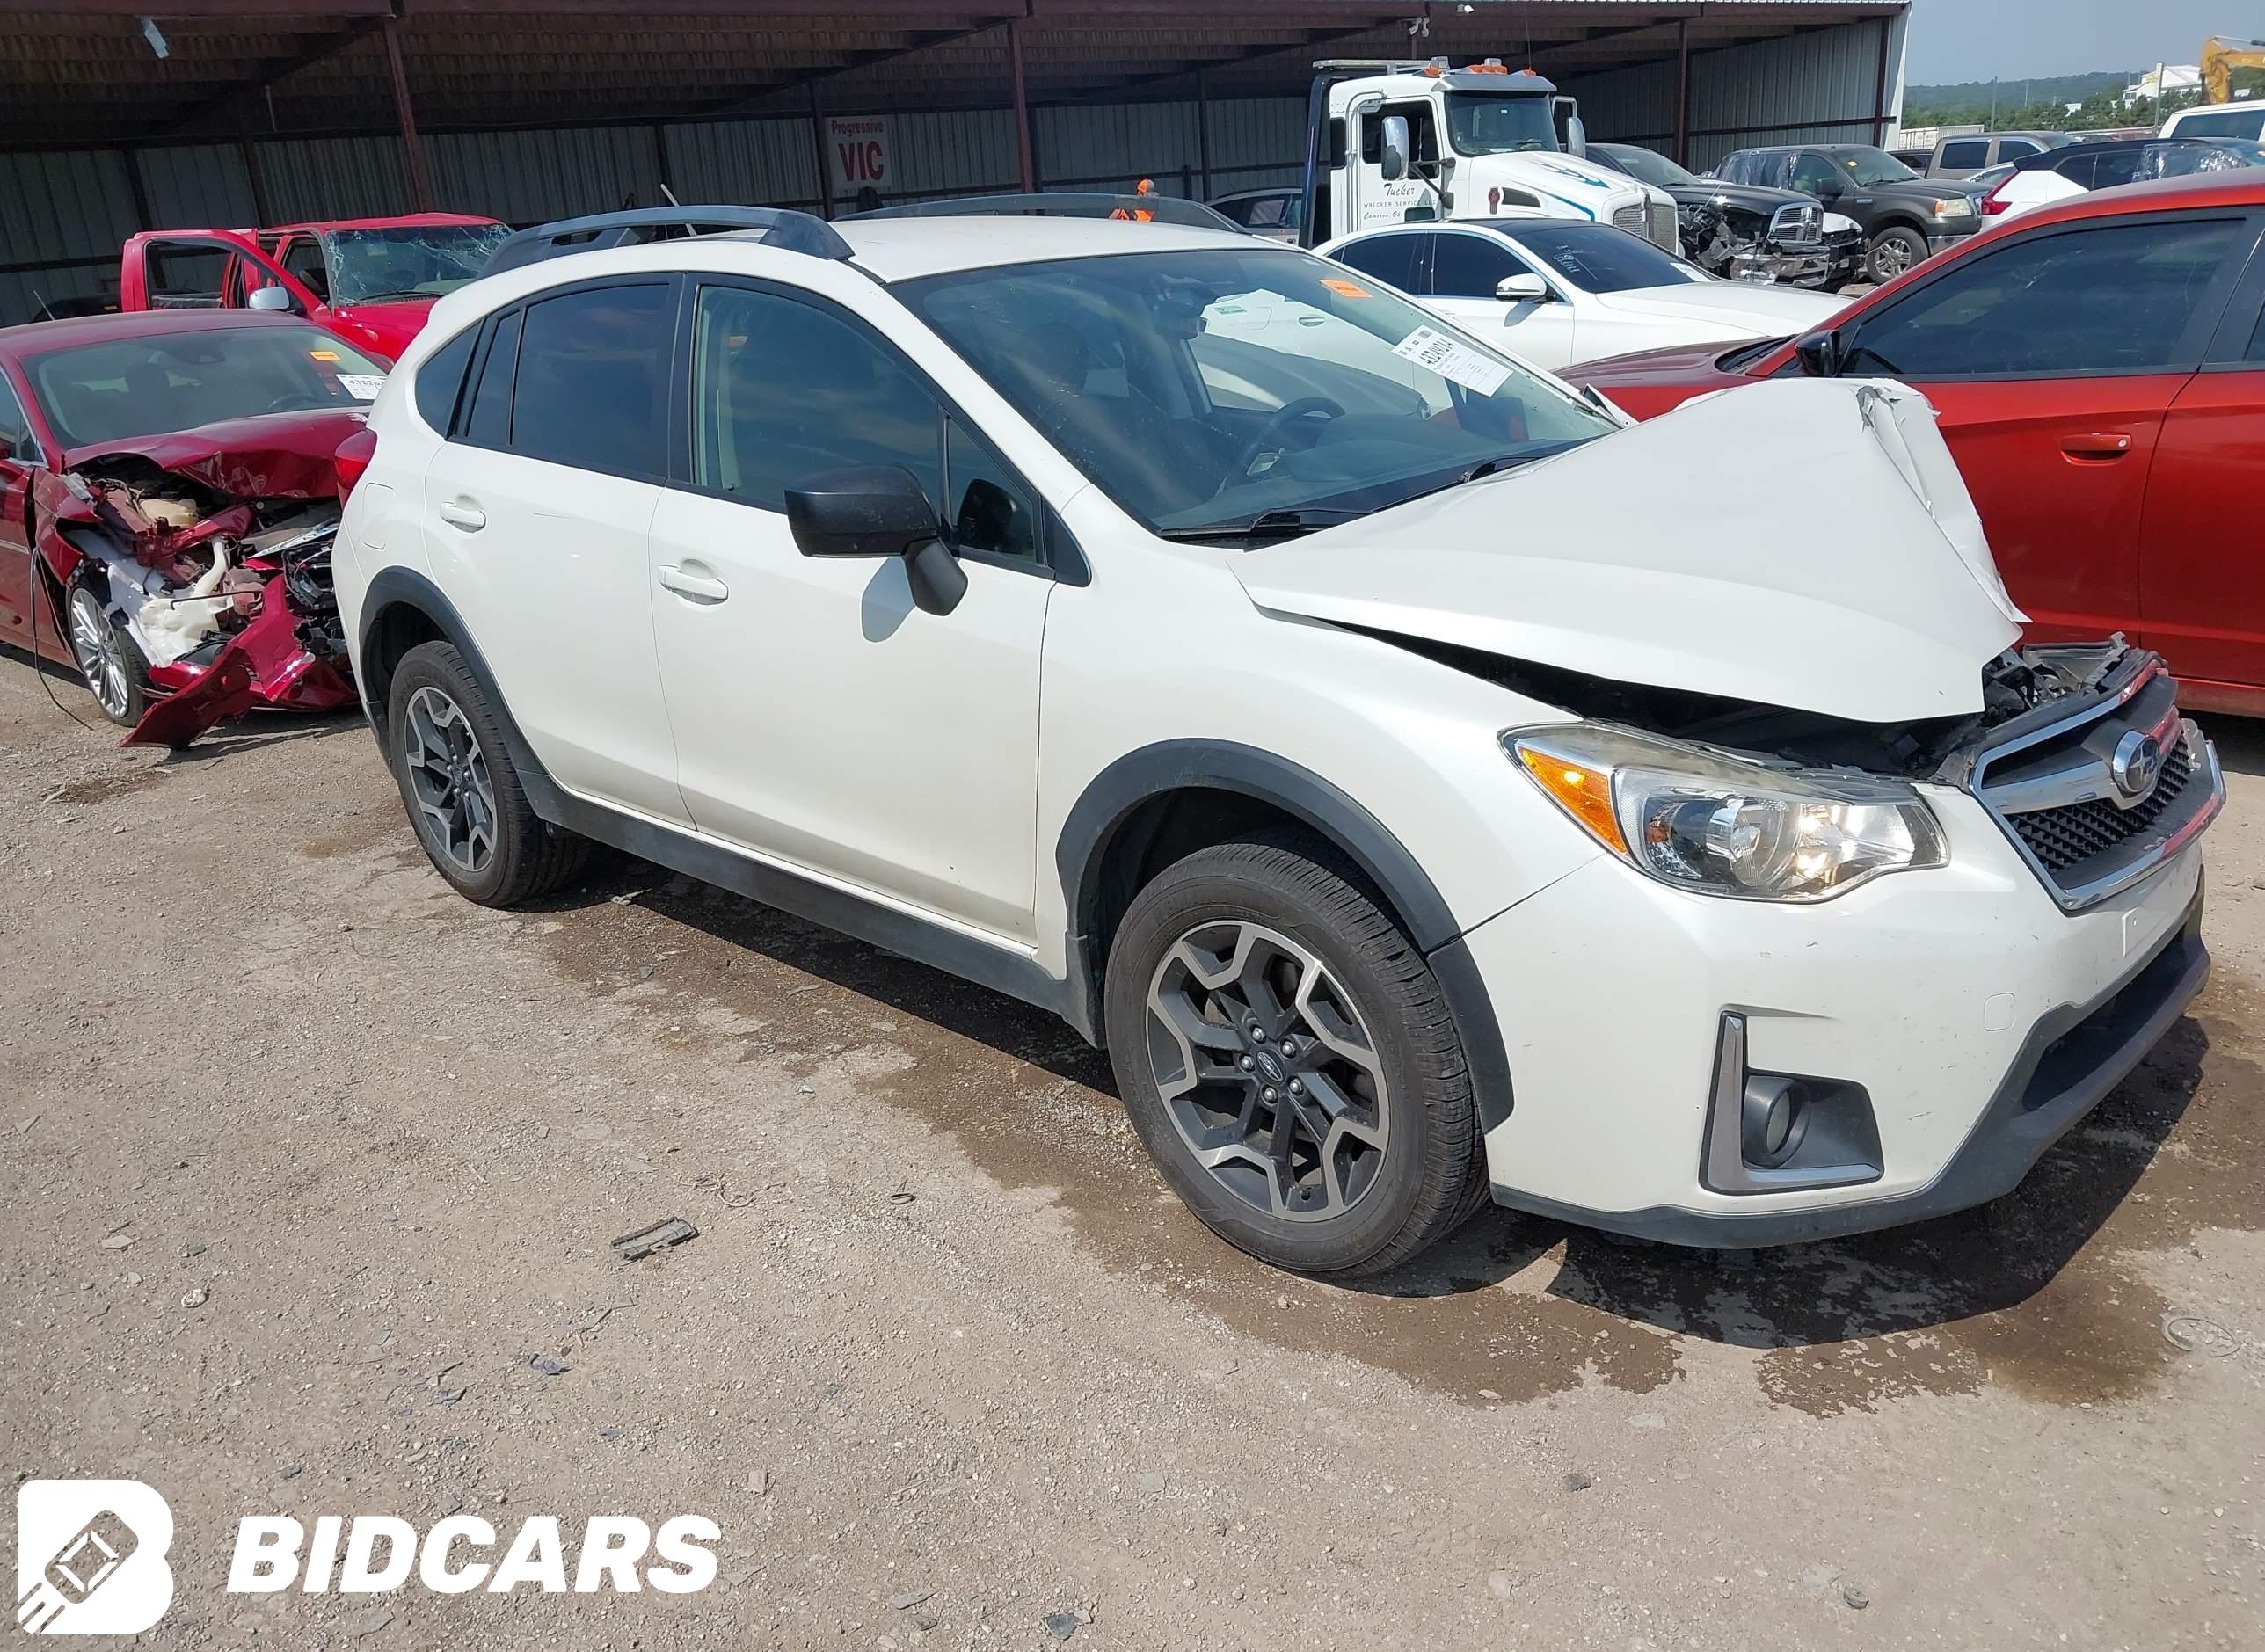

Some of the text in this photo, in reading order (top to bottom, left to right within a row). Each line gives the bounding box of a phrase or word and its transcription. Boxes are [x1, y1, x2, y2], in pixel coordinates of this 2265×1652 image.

[831, 119, 884, 137] Progressive
[838, 141, 884, 182] VIC
[1383, 182, 1415, 197] Tucker
